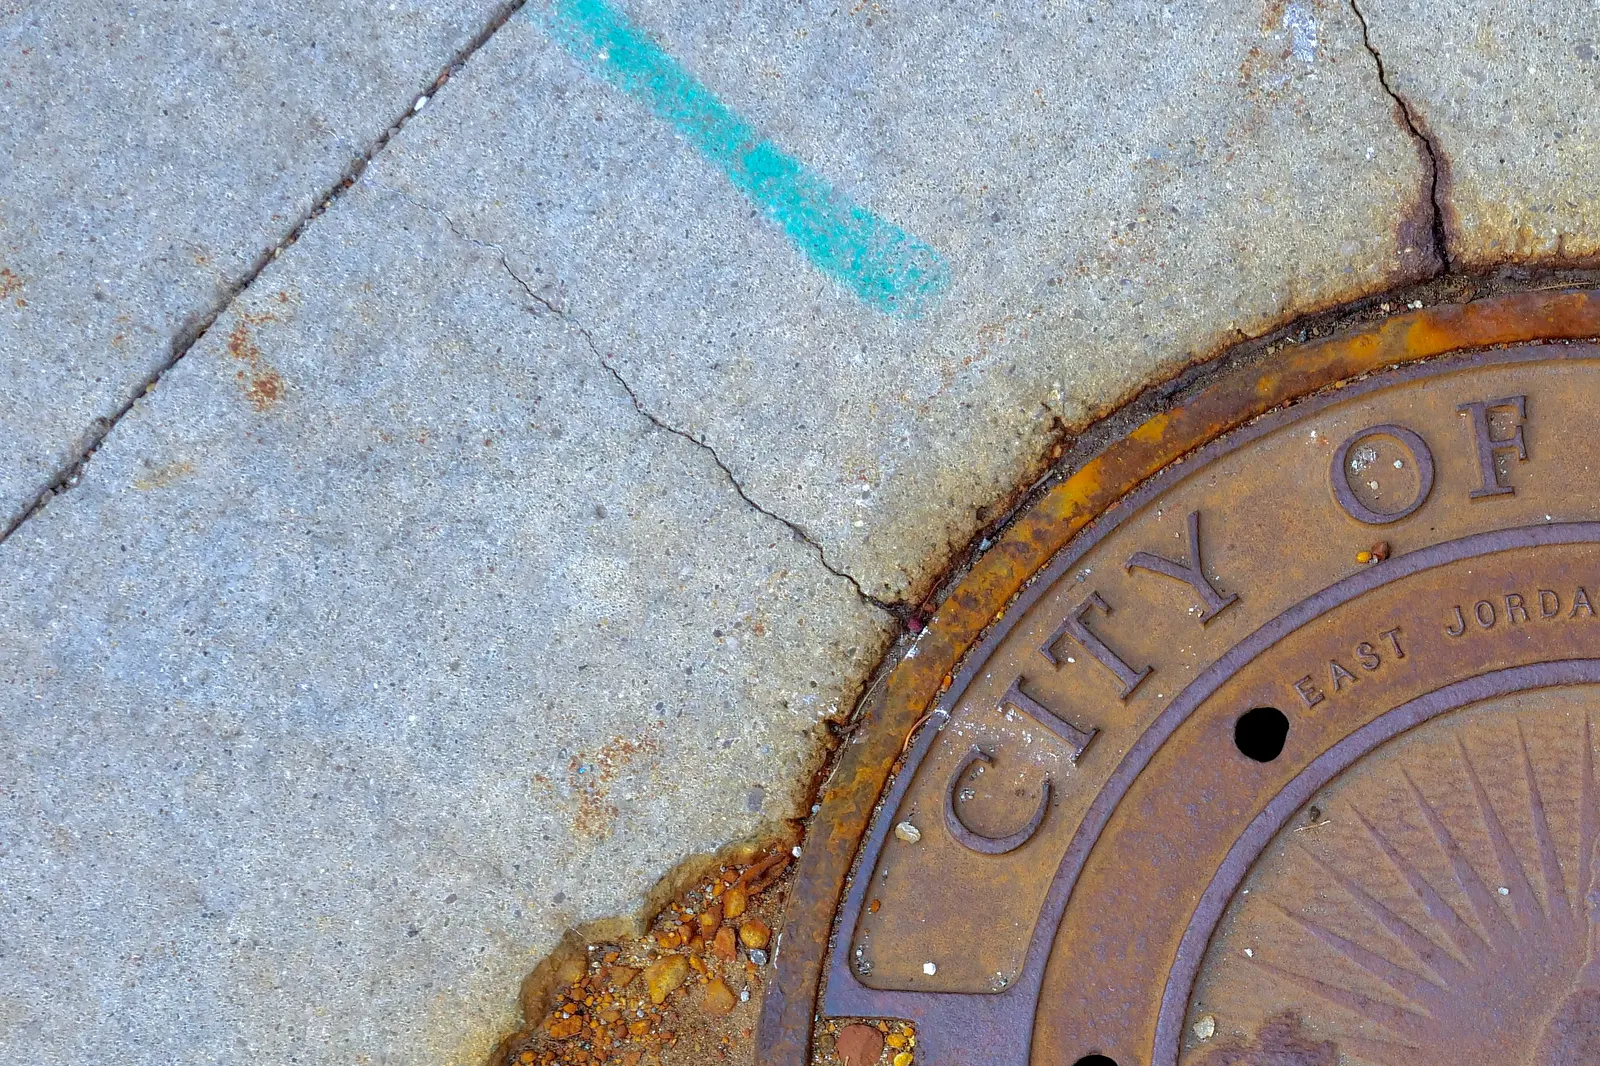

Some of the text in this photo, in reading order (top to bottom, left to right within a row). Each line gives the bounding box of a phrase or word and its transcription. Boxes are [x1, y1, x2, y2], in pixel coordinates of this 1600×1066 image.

[944, 511, 1239, 855] CITY
[1329, 395, 1529, 525] OF
[1292, 627, 1406, 709] EAST
